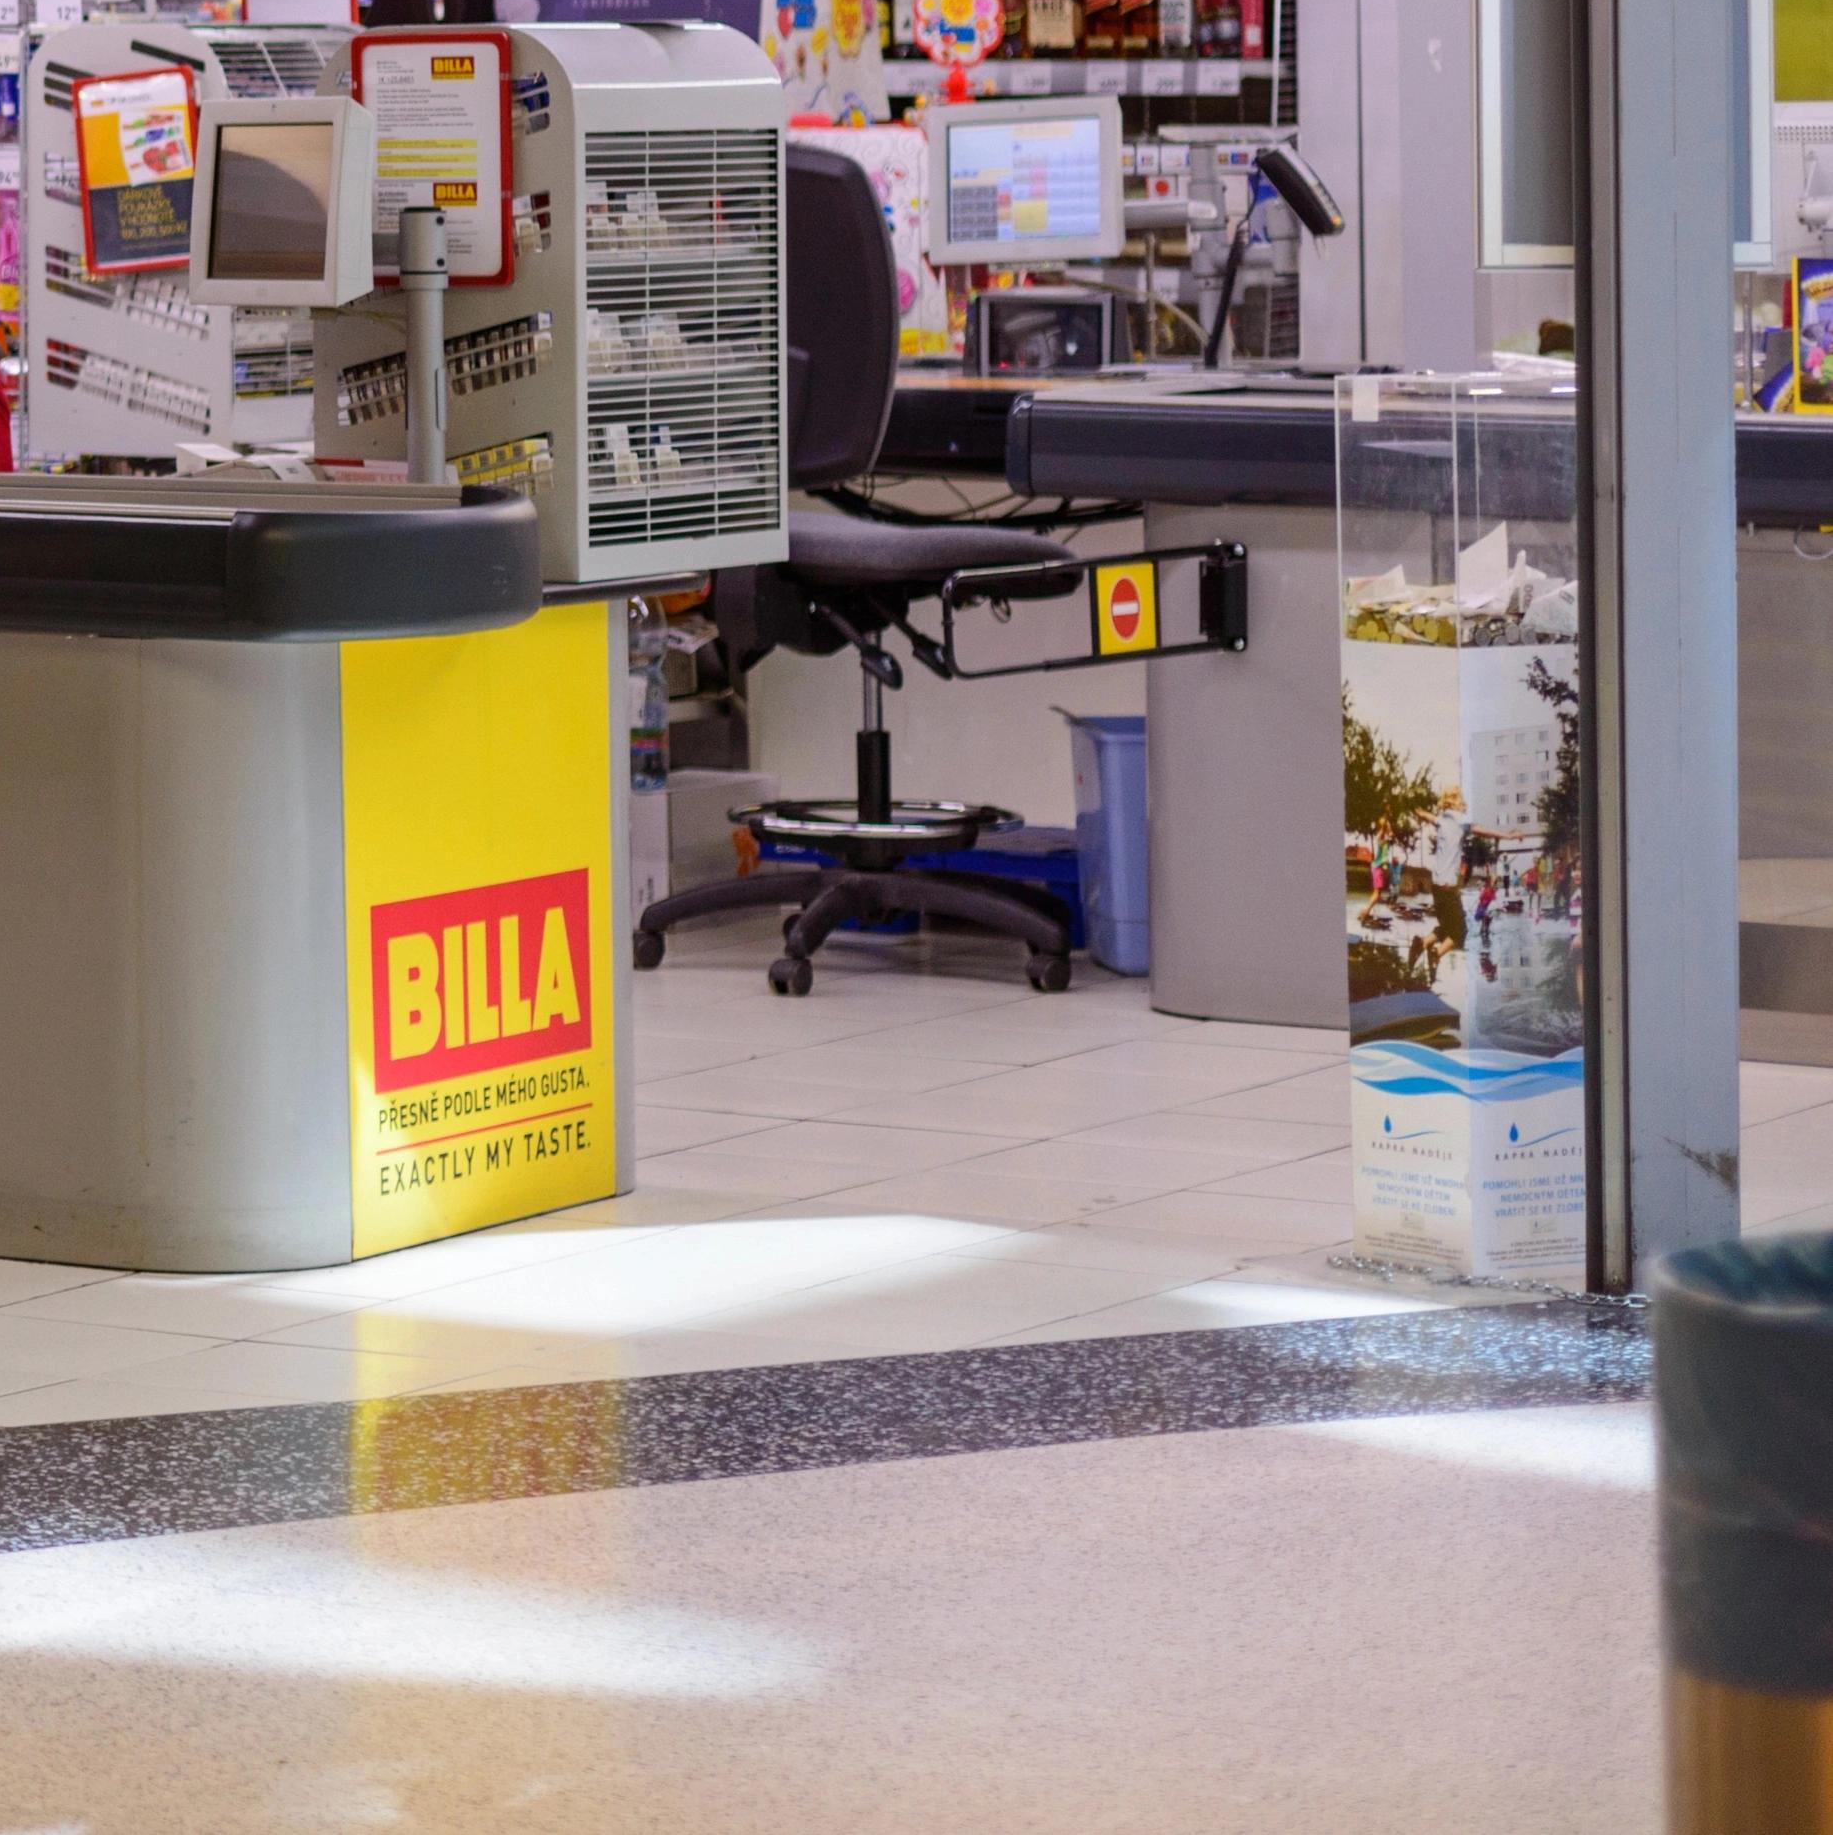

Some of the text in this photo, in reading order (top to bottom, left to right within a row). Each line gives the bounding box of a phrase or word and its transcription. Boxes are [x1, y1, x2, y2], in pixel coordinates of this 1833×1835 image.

[433, 58, 473, 74] BILLA
[435, 185, 476, 200] BILLA
[387, 905, 582, 1062] BILLA
[377, 1065, 591, 1134] PŘESNĚ PODLE MÉHO GUSTA.
[380, 1119, 592, 1197] EXACTLY MY TASTE.
[1494, 1150, 1535, 1162] KAPKA
